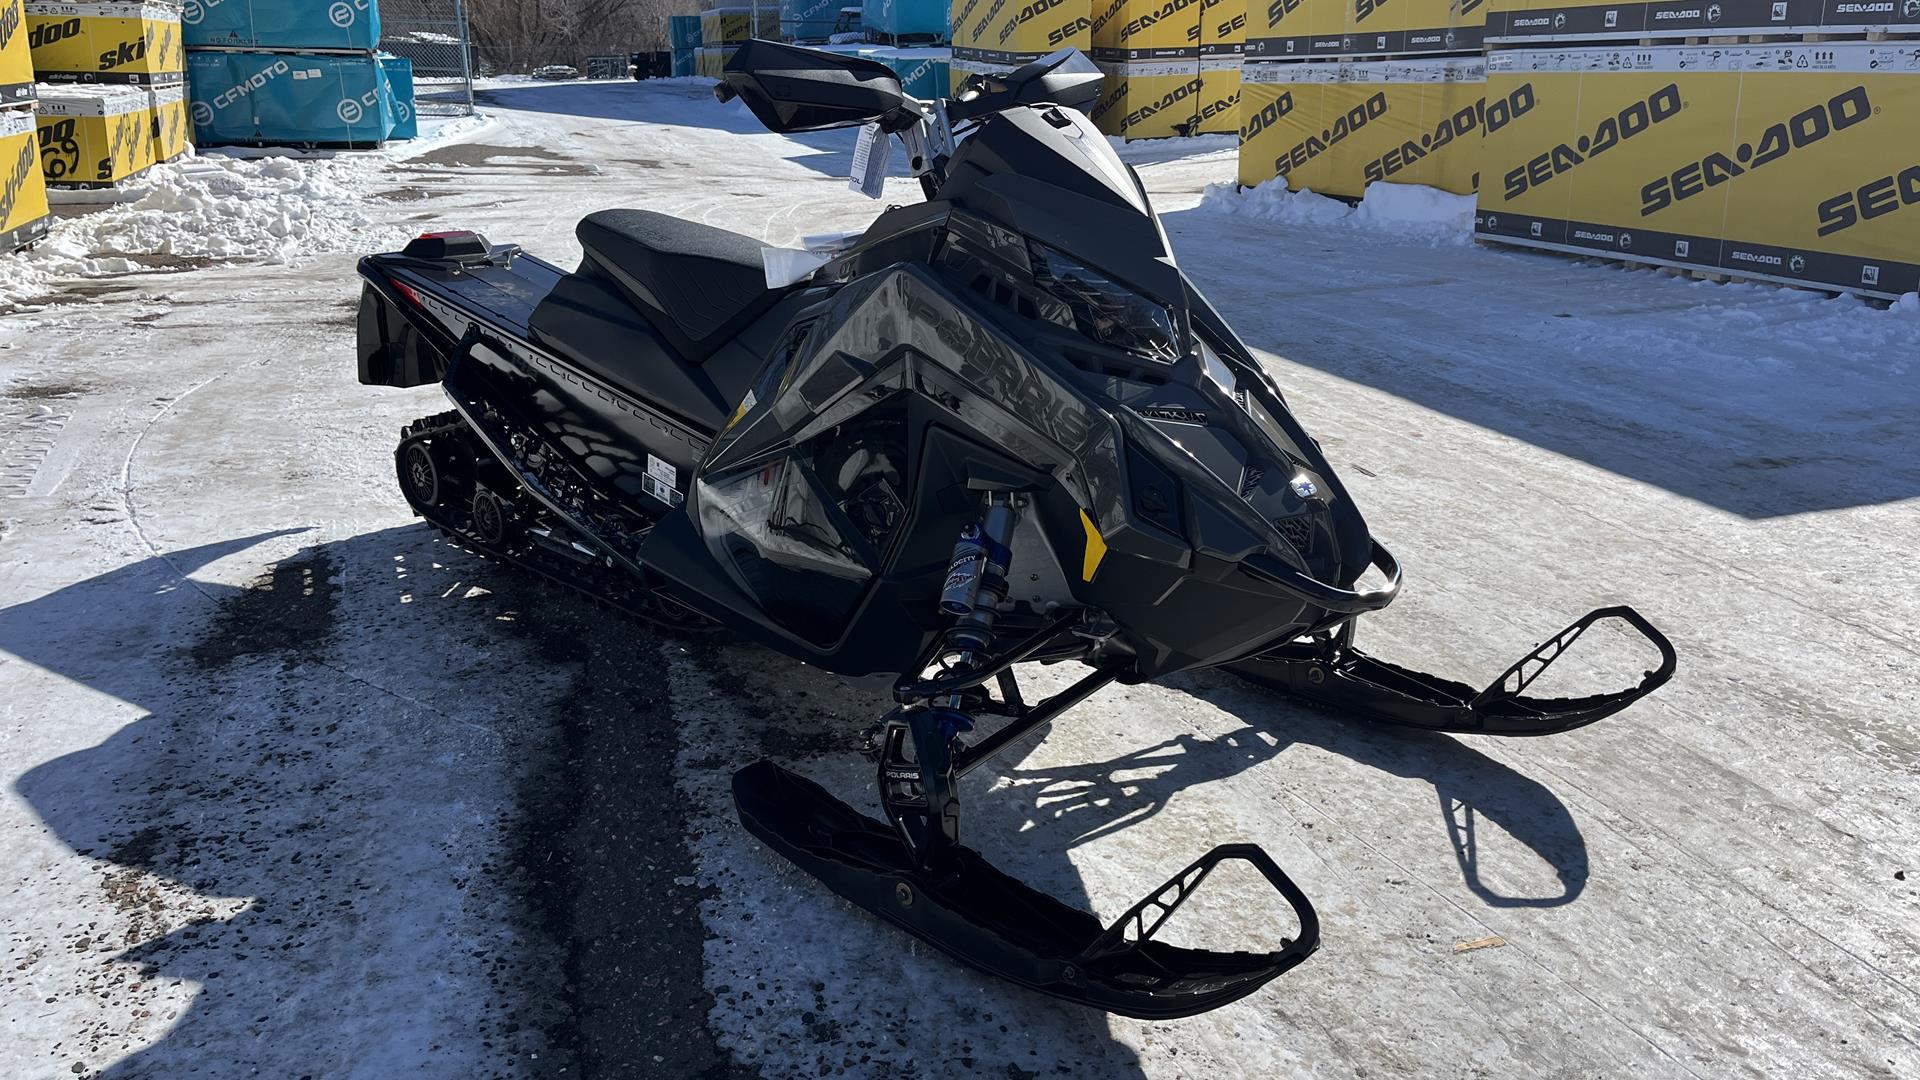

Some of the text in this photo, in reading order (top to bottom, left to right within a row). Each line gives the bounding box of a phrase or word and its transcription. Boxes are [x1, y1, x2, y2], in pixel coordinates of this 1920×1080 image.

[213, 60, 289, 109] CFMOTO
[908, 298, 1090, 450] POLARIS
[886, 770, 920, 780] POLARIS
